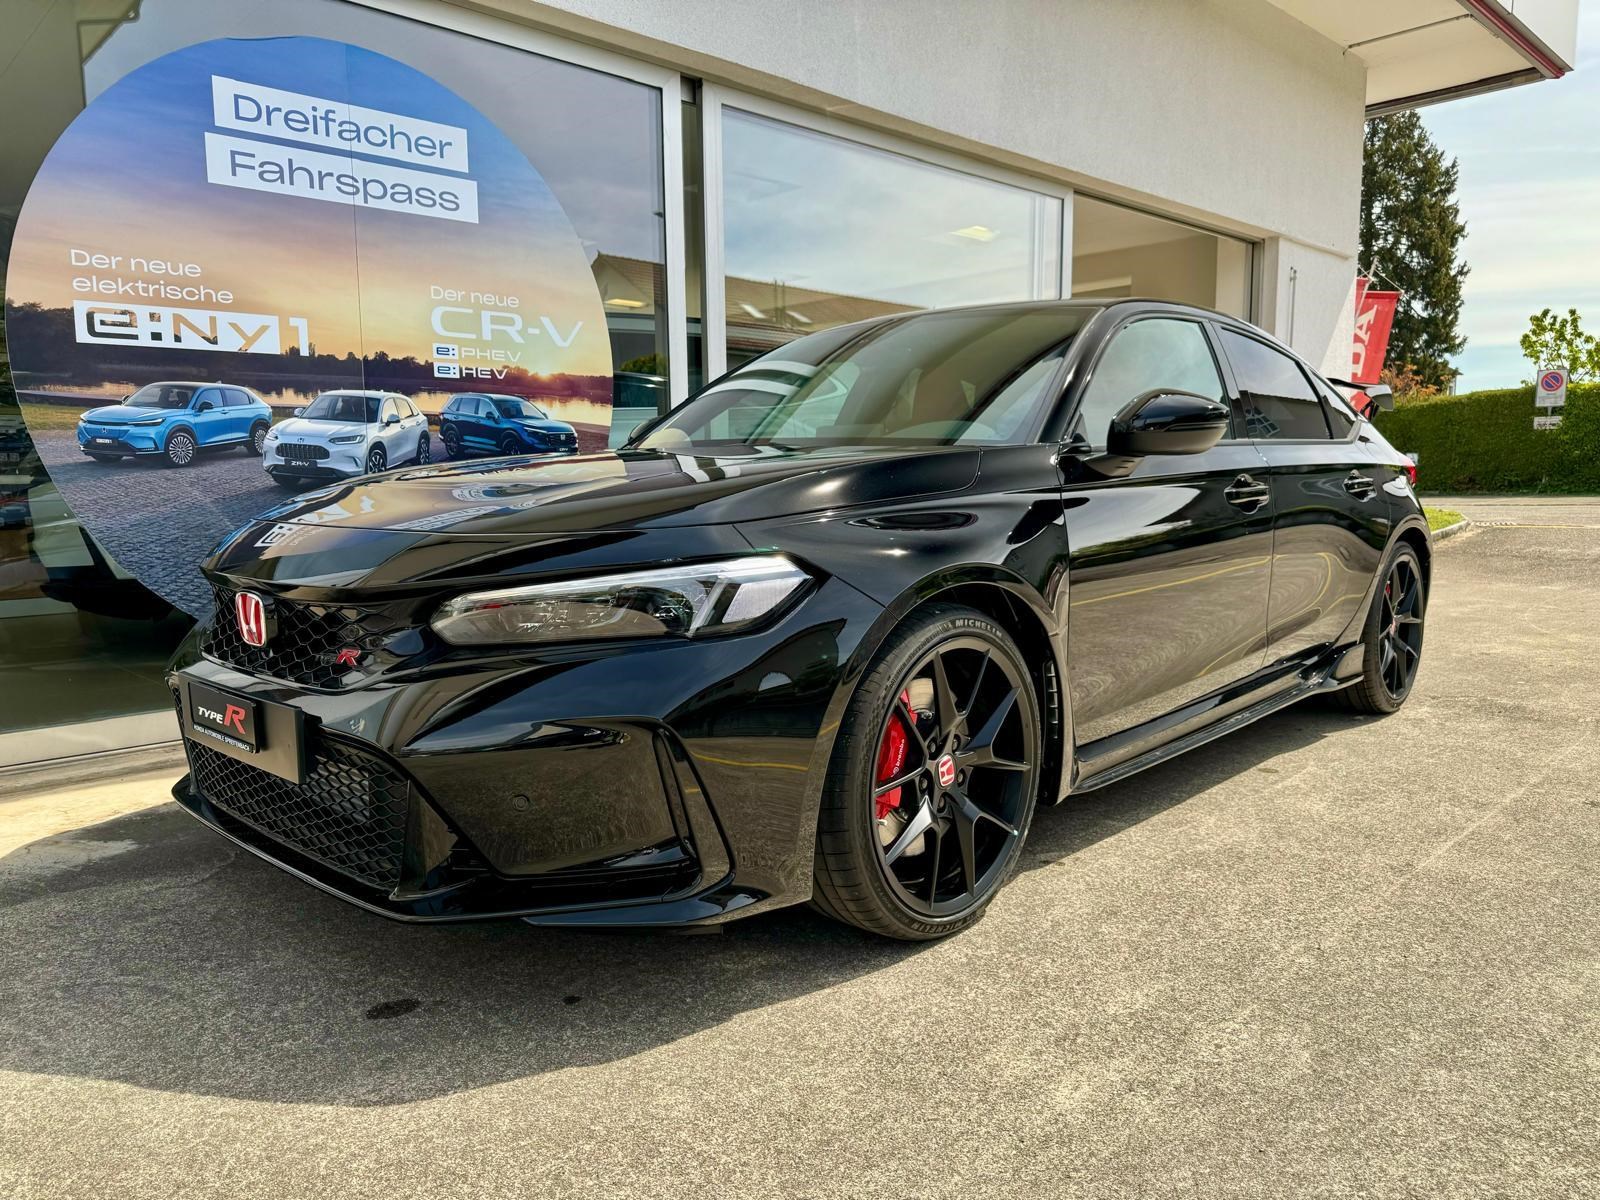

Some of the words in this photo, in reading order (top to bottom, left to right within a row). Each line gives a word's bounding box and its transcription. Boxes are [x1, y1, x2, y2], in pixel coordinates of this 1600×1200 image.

[233, 93, 452, 159] Dreifacher
[229, 149, 460, 212] Fahrspass
[70, 248, 122, 270] Der
[130, 257, 202, 278] neue
[72, 275, 233, 304] elektrische
[430, 285, 464, 302] Der
[470, 292, 520, 308] neue
[431, 305, 584, 348] CR-V
[955, 618, 1003, 638] MICHELIN
[197, 706, 224, 725] TYPE
[223, 703, 247, 735] R
[895, 738, 905, 767] brembo
